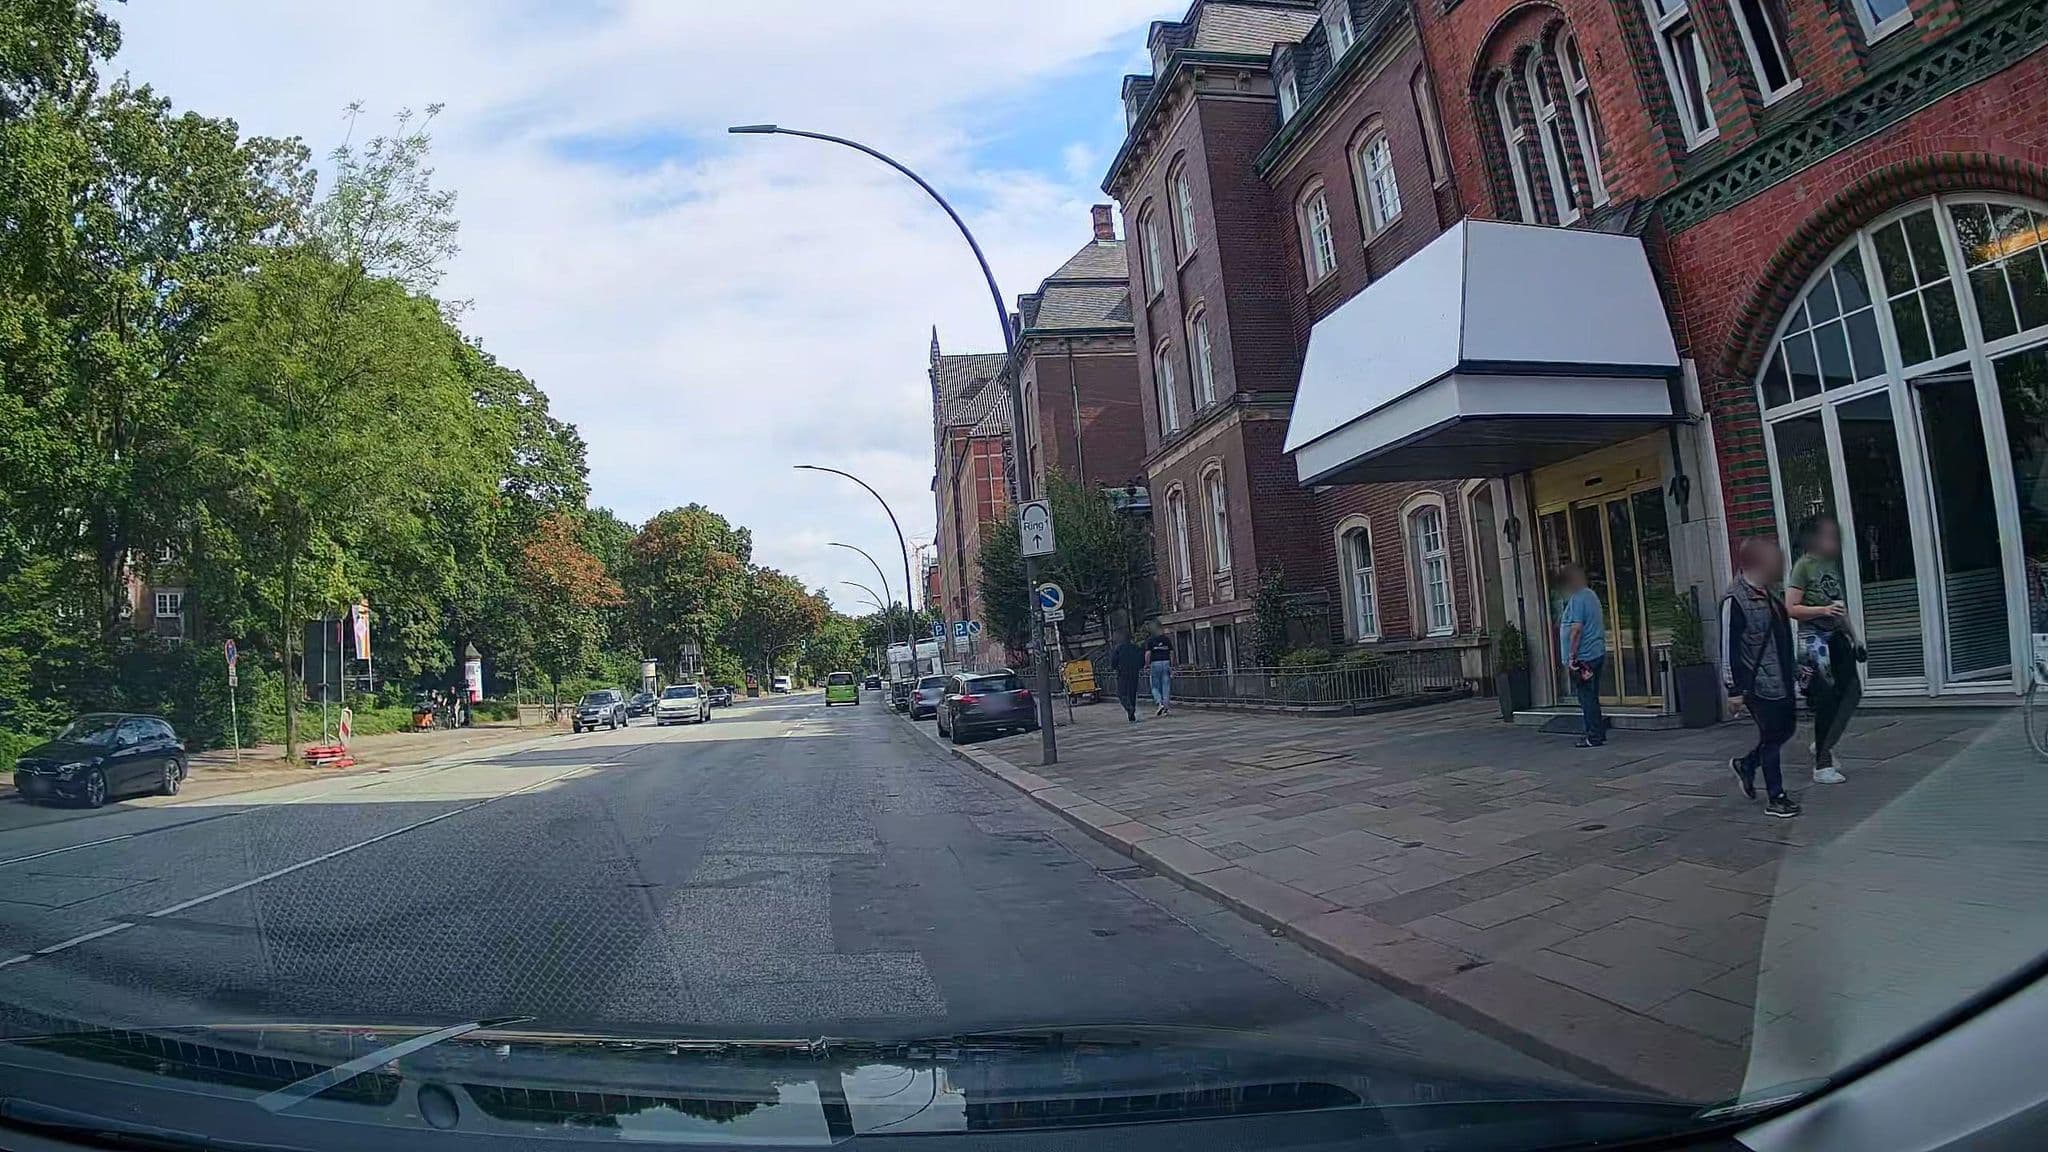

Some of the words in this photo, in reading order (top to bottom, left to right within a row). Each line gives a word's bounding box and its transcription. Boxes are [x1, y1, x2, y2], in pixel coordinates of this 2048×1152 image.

[1023, 521, 1044, 531] Ring
[935, 625, 943, 636] P
[955, 623, 963, 636] P
